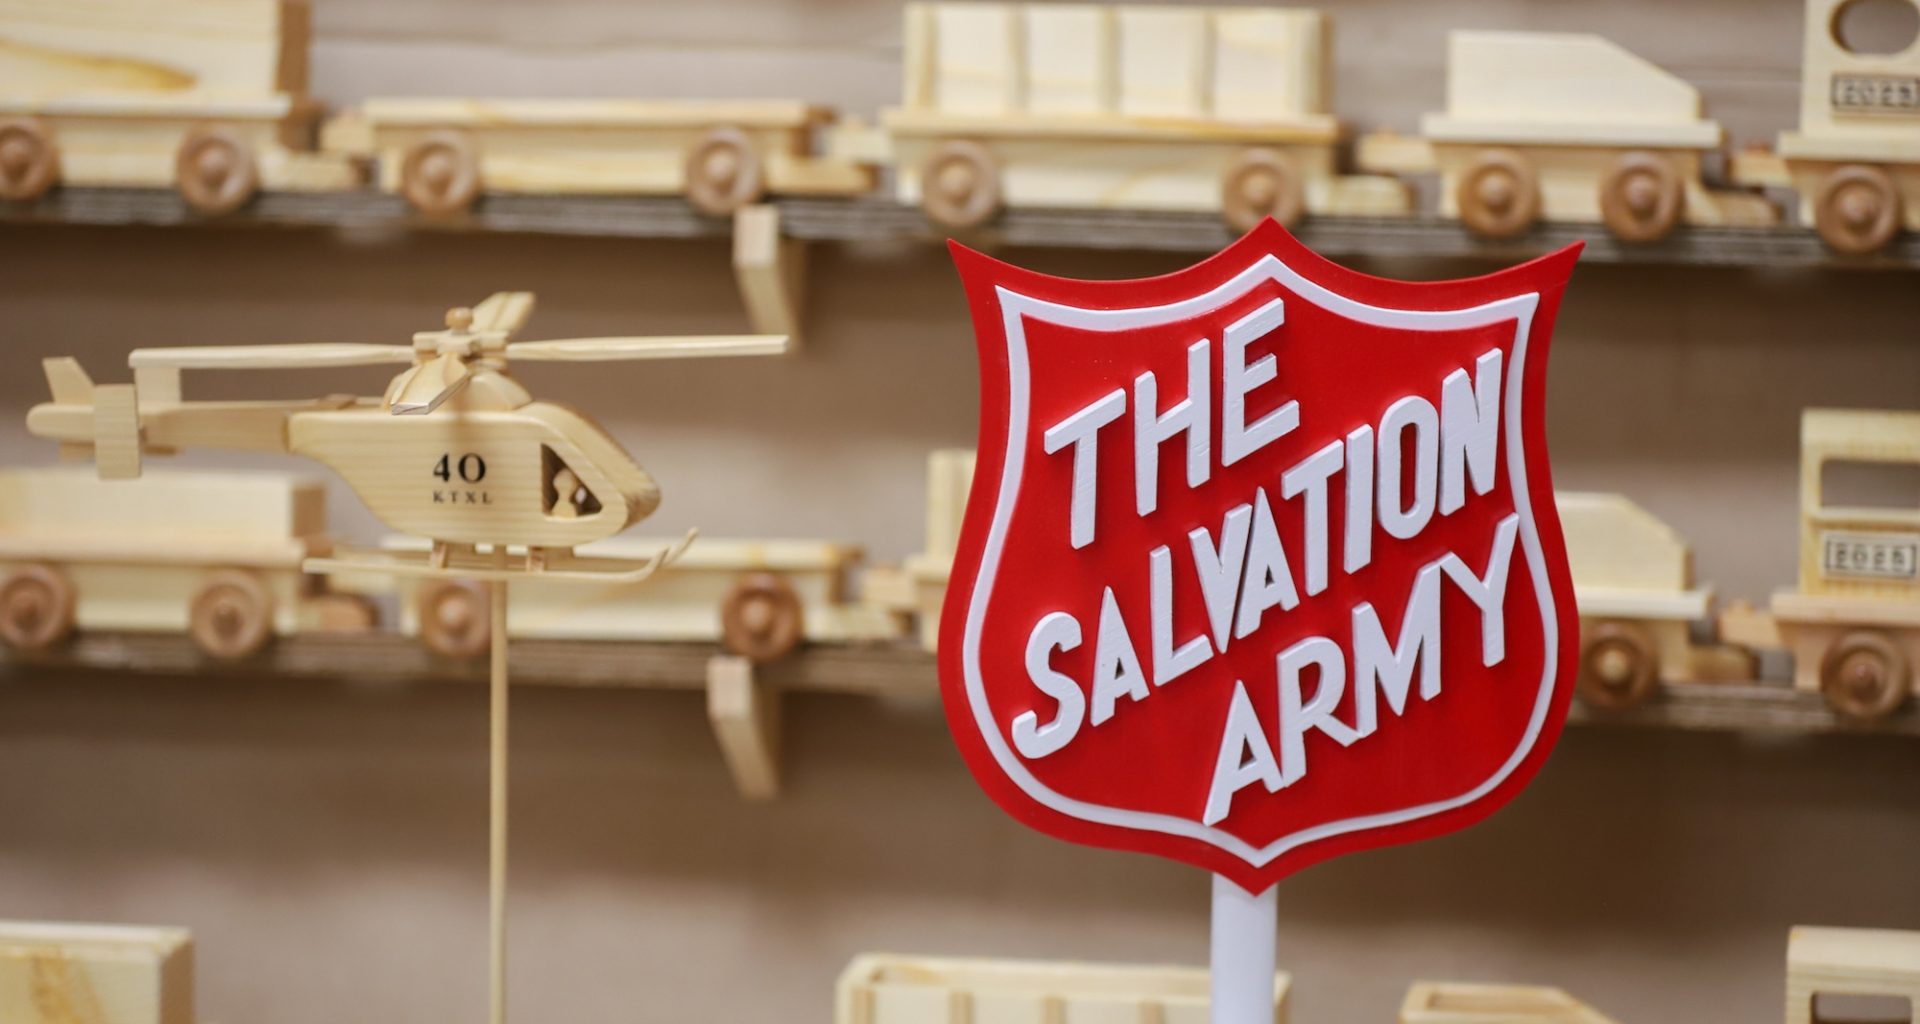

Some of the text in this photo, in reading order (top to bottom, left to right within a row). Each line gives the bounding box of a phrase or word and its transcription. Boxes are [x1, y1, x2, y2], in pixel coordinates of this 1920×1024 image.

[432, 490, 494, 505] KTXL
[433, 452, 487, 484] 40
[1044, 297, 1300, 550] THE
[1011, 347, 1504, 759] SALVATION
[1203, 512, 1520, 827] ARMY
